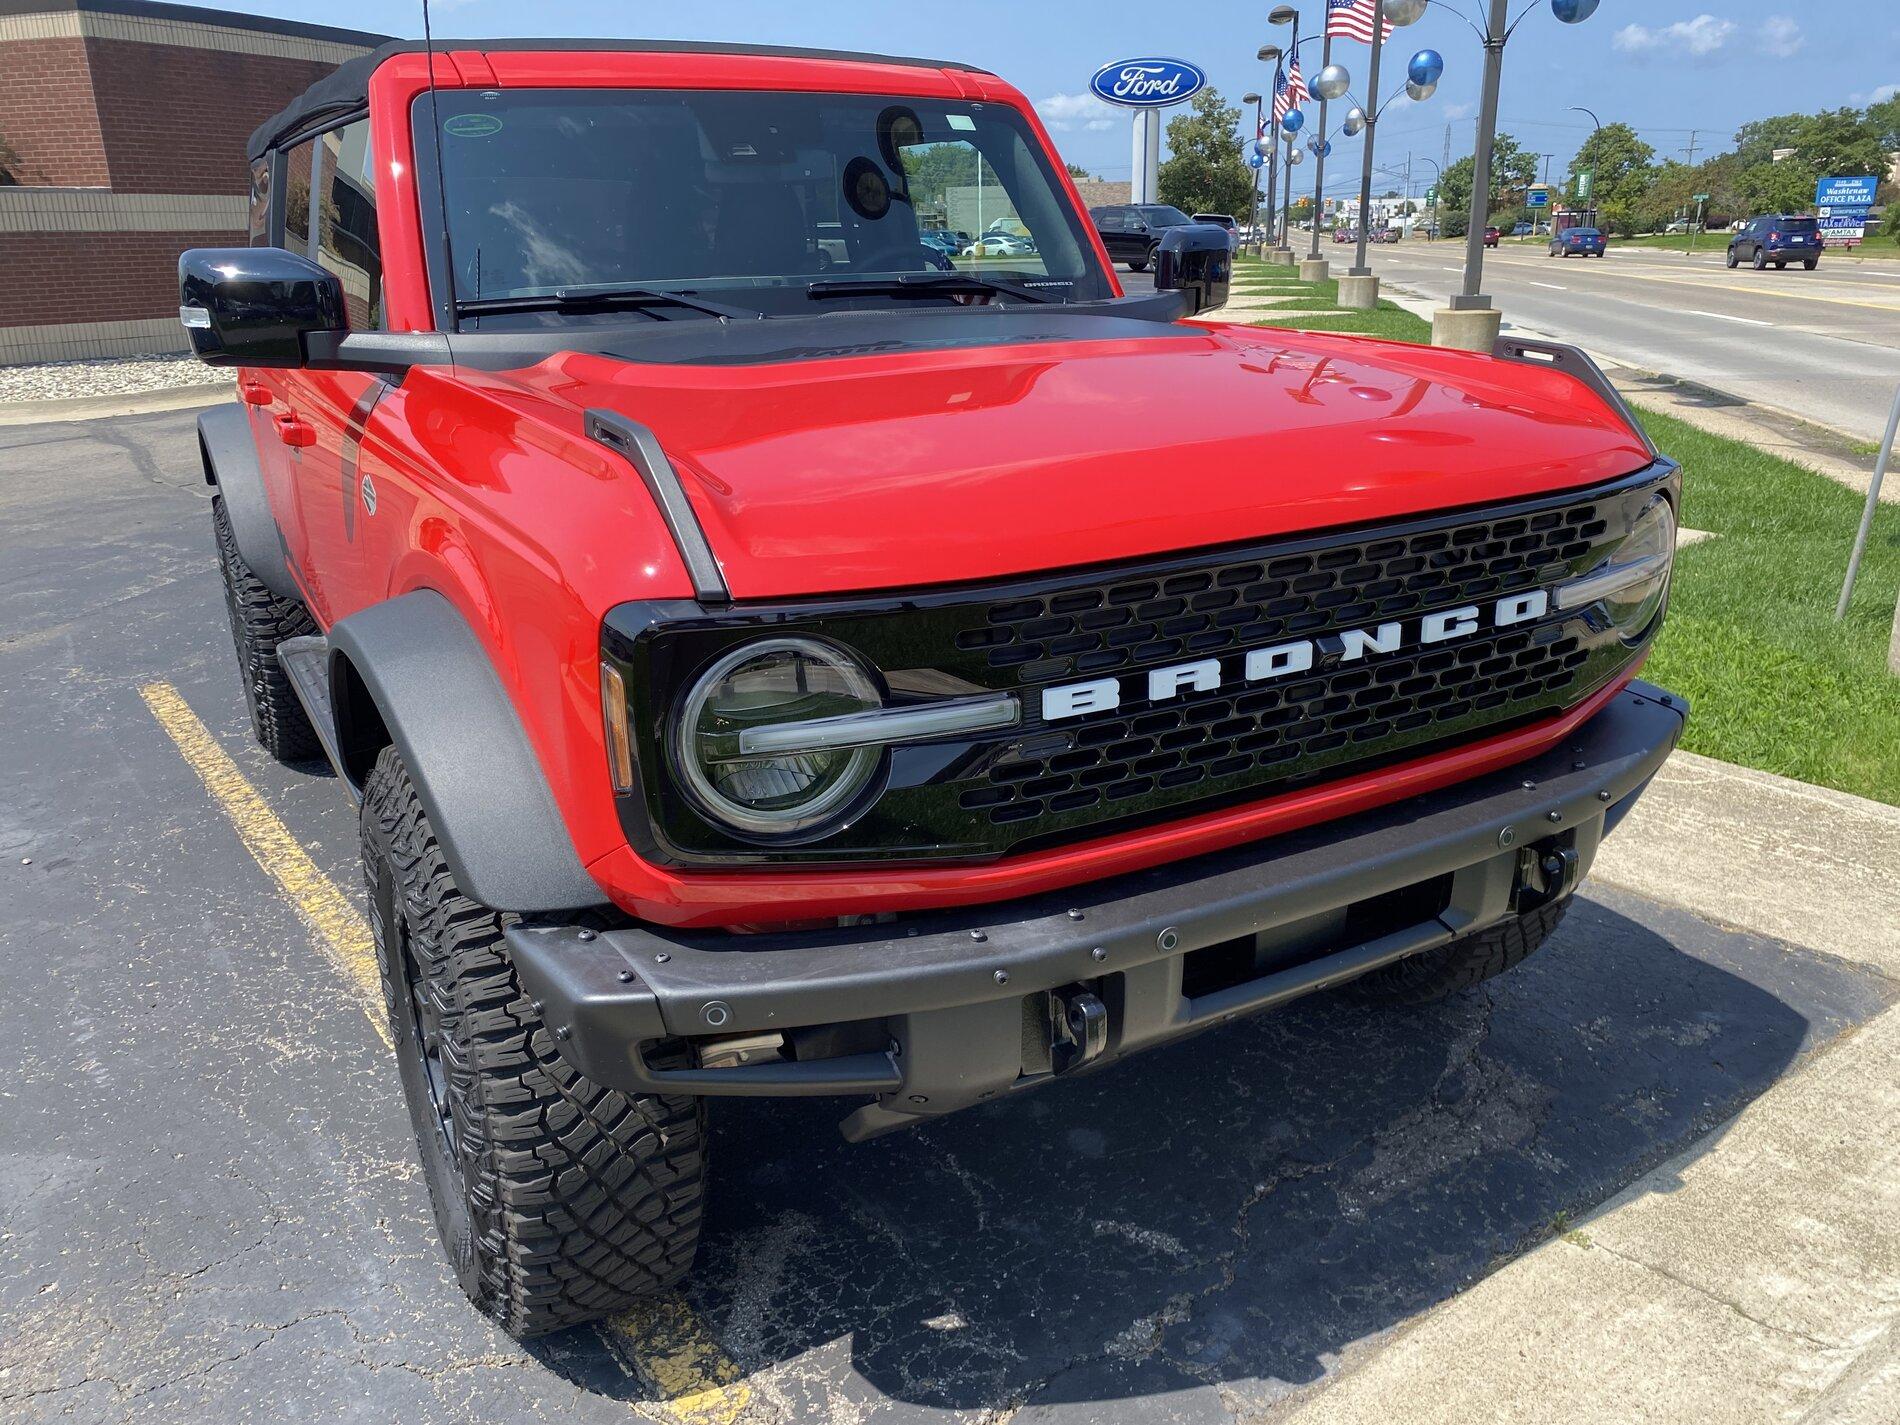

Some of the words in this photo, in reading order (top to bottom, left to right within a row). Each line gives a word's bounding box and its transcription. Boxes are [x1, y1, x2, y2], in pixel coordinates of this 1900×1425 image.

[1113, 66, 1182, 96] Ford
[1578, 175, 1586, 197] EASTERN
[1042, 589, 1548, 721] BRONCO
